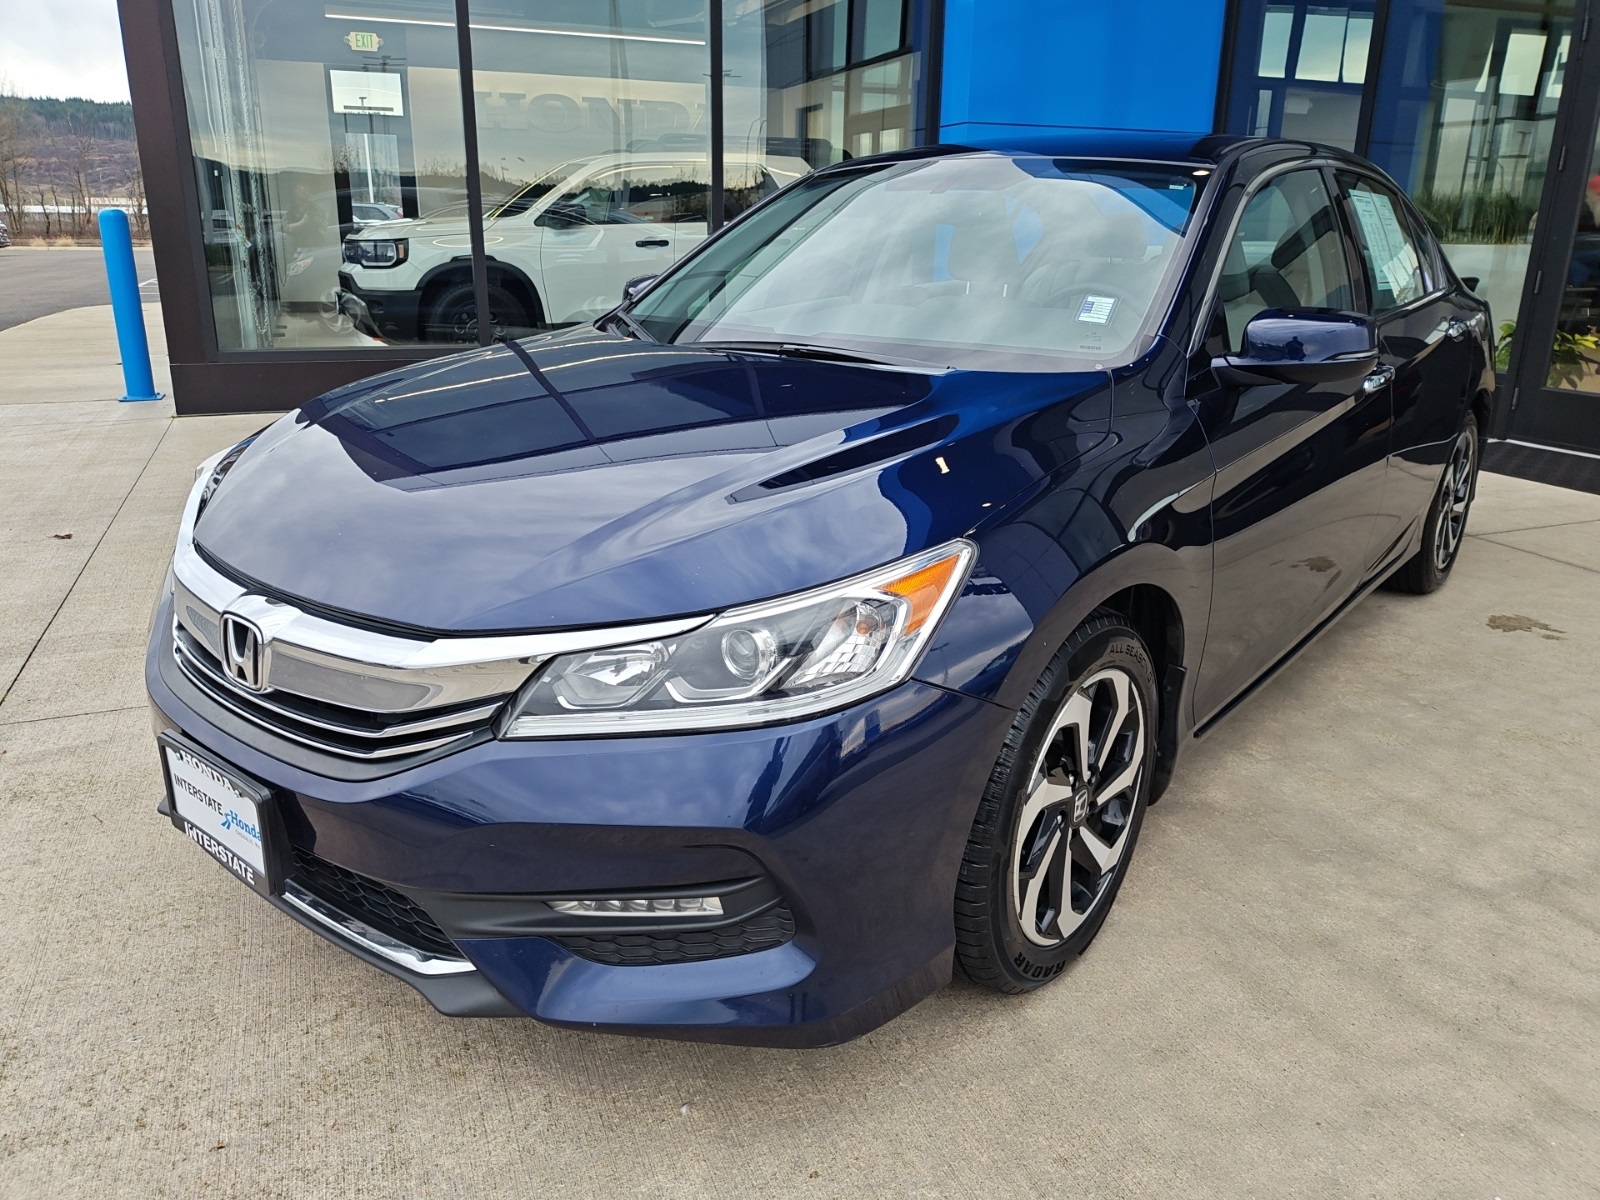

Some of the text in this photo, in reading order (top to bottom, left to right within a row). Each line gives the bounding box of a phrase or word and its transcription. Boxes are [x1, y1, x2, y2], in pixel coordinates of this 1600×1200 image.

[355, 33, 374, 49] EXIT
[1109, 643, 1124, 655] ALL
[180, 750, 235, 791] HONDA
[174, 773, 223, 816] INTERSTATE
[184, 821, 255, 885] INTERSTATE
[1013, 951, 1066, 978] RADAR
